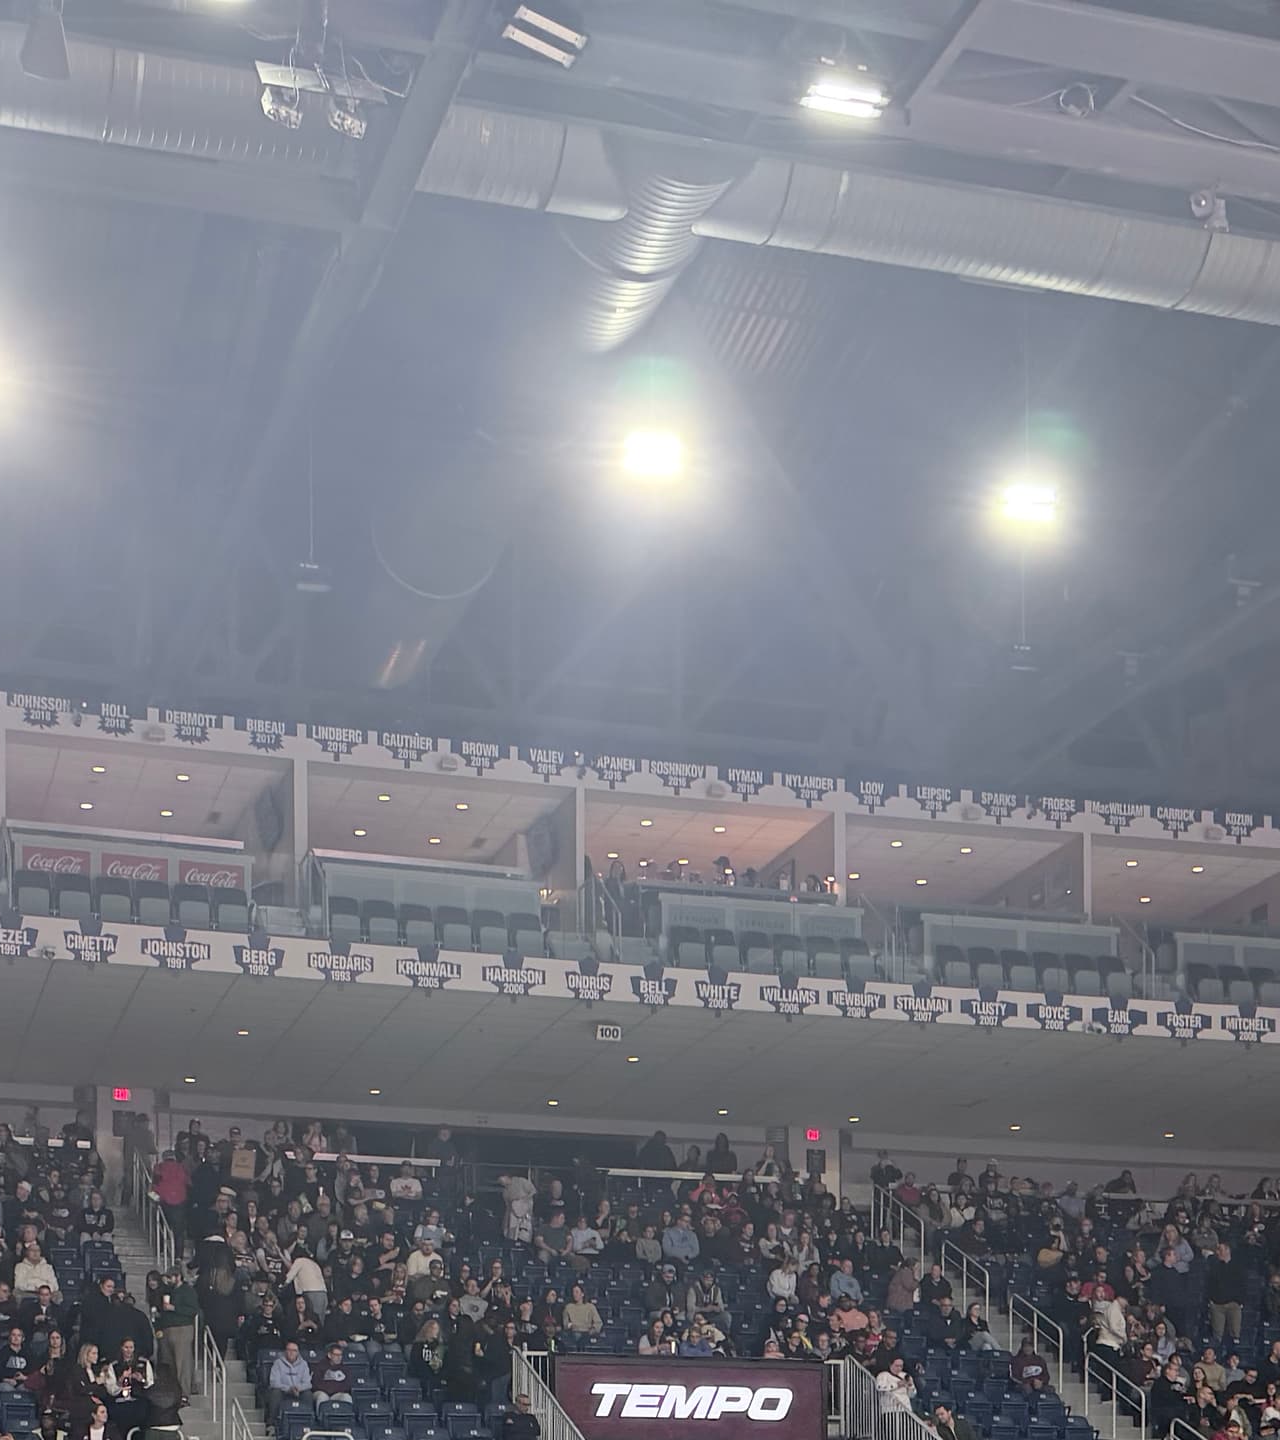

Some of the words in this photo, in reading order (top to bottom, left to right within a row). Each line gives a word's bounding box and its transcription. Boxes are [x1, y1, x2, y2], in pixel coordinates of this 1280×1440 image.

[10, 694, 71, 712] JOHNSSON
[101, 703, 129, 718] HOLL
[165, 710, 217, 729] DERMOTT
[247, 719, 285, 735] BIBEAU
[312, 726, 362, 743] LINDBERG
[383, 732, 433, 752] GAUTHIER
[462, 741, 499, 757] BROWN
[530, 749, 564, 765] VALIEV
[651, 761, 704, 779] SOSHNIKOV
[728, 768, 763, 785] HYMAN
[785, 773, 834, 792] NYLANDER
[917, 786, 951, 802] LEIPSIC
[981, 792, 1016, 808] SPARKS
[1157, 807, 1194, 823] CARRICK
[0, 943, 21, 956] 1991
[67, 933, 115, 952] CIMETTA
[144, 940, 208, 959] JOHNSTON
[80, 949, 101, 962] 1991
[166, 957, 186, 969] 1991
[242, 950, 276, 966] BERG
[310, 953, 372, 972] GOVEDARIS
[249, 963, 269, 975] 1992
[331, 969, 351, 981] 1993
[397, 960, 460, 979] KRONWALL
[486, 968, 543, 984] HARRISON
[418, 976, 439, 988] 2005
[569, 975, 610, 990] ONDRUS
[640, 981, 668, 995] BELL
[699, 984, 738, 1000] WHITE
[764, 987, 816, 1003] WILLIAMS
[833, 991, 880, 1007] NEWBURY
[897, 996, 948, 1013] STRALMAN
[971, 1001, 1006, 1017] TLUSTY
[1039, 1005, 1070, 1020] BOYCE
[980, 1014, 998, 1026] 2007
[1108, 1010, 1131, 1024] EARL
[1167, 1014, 1201, 1028] FOSTER
[1226, 1017, 1269, 1032] MITCHELL
[600, 1028, 619, 1039] 100
[591, 1383, 793, 1421] TEMPO
